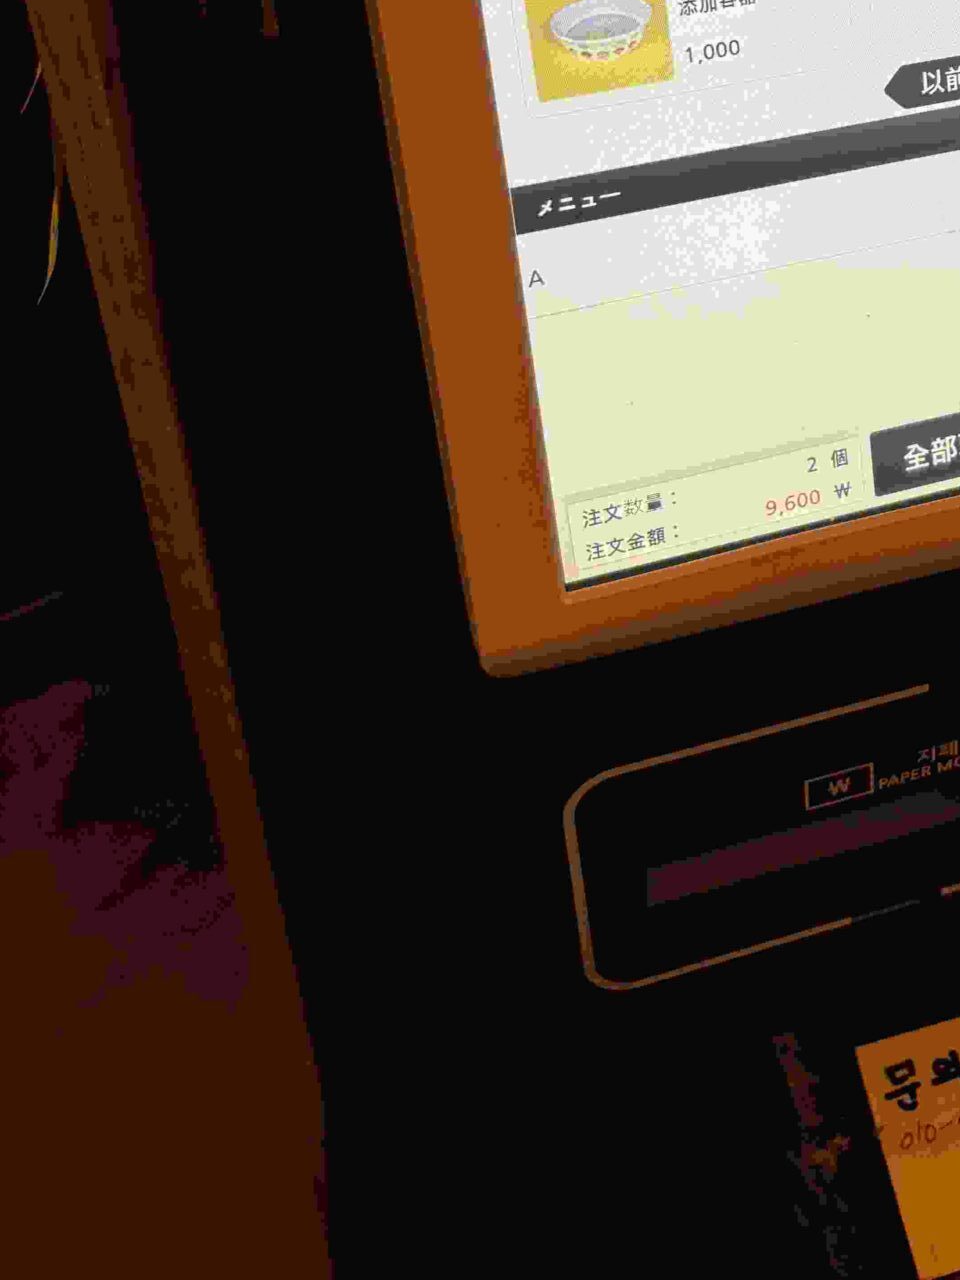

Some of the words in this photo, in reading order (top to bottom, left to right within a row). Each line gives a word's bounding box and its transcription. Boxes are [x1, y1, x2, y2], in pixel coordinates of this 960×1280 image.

[685, 39, 741, 64] 1,000
[537, 191, 622, 217] メニュー
[528, 269, 545, 289] A
[806, 456, 819, 474] 2
[830, 448, 849, 469] 個
[765, 488, 822, 518] 9,600
[877, 762, 931, 791] PAPER
